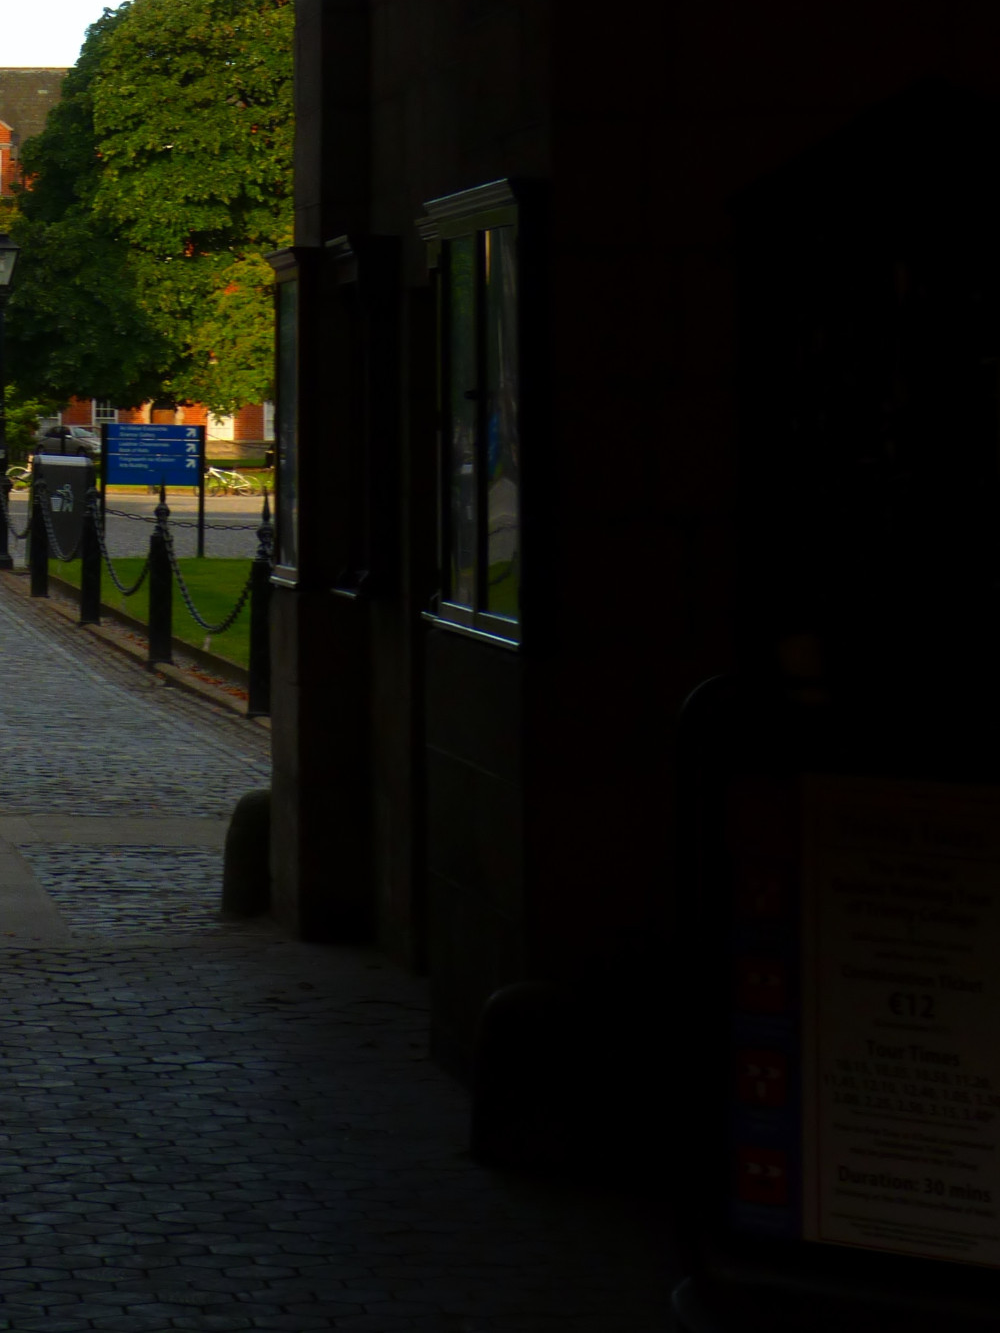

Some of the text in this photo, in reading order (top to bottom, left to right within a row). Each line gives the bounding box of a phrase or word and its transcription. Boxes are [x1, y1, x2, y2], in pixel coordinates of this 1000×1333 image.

[841, 963, 985, 995] Combination Ticket
[888, 991, 935, 1019] €12
[865, 1039, 960, 1067] Tour Times
[837, 1164, 920, 1193] Duration:
[924, 1177, 946, 1196] 30
[949, 1183, 992, 1204] mins
